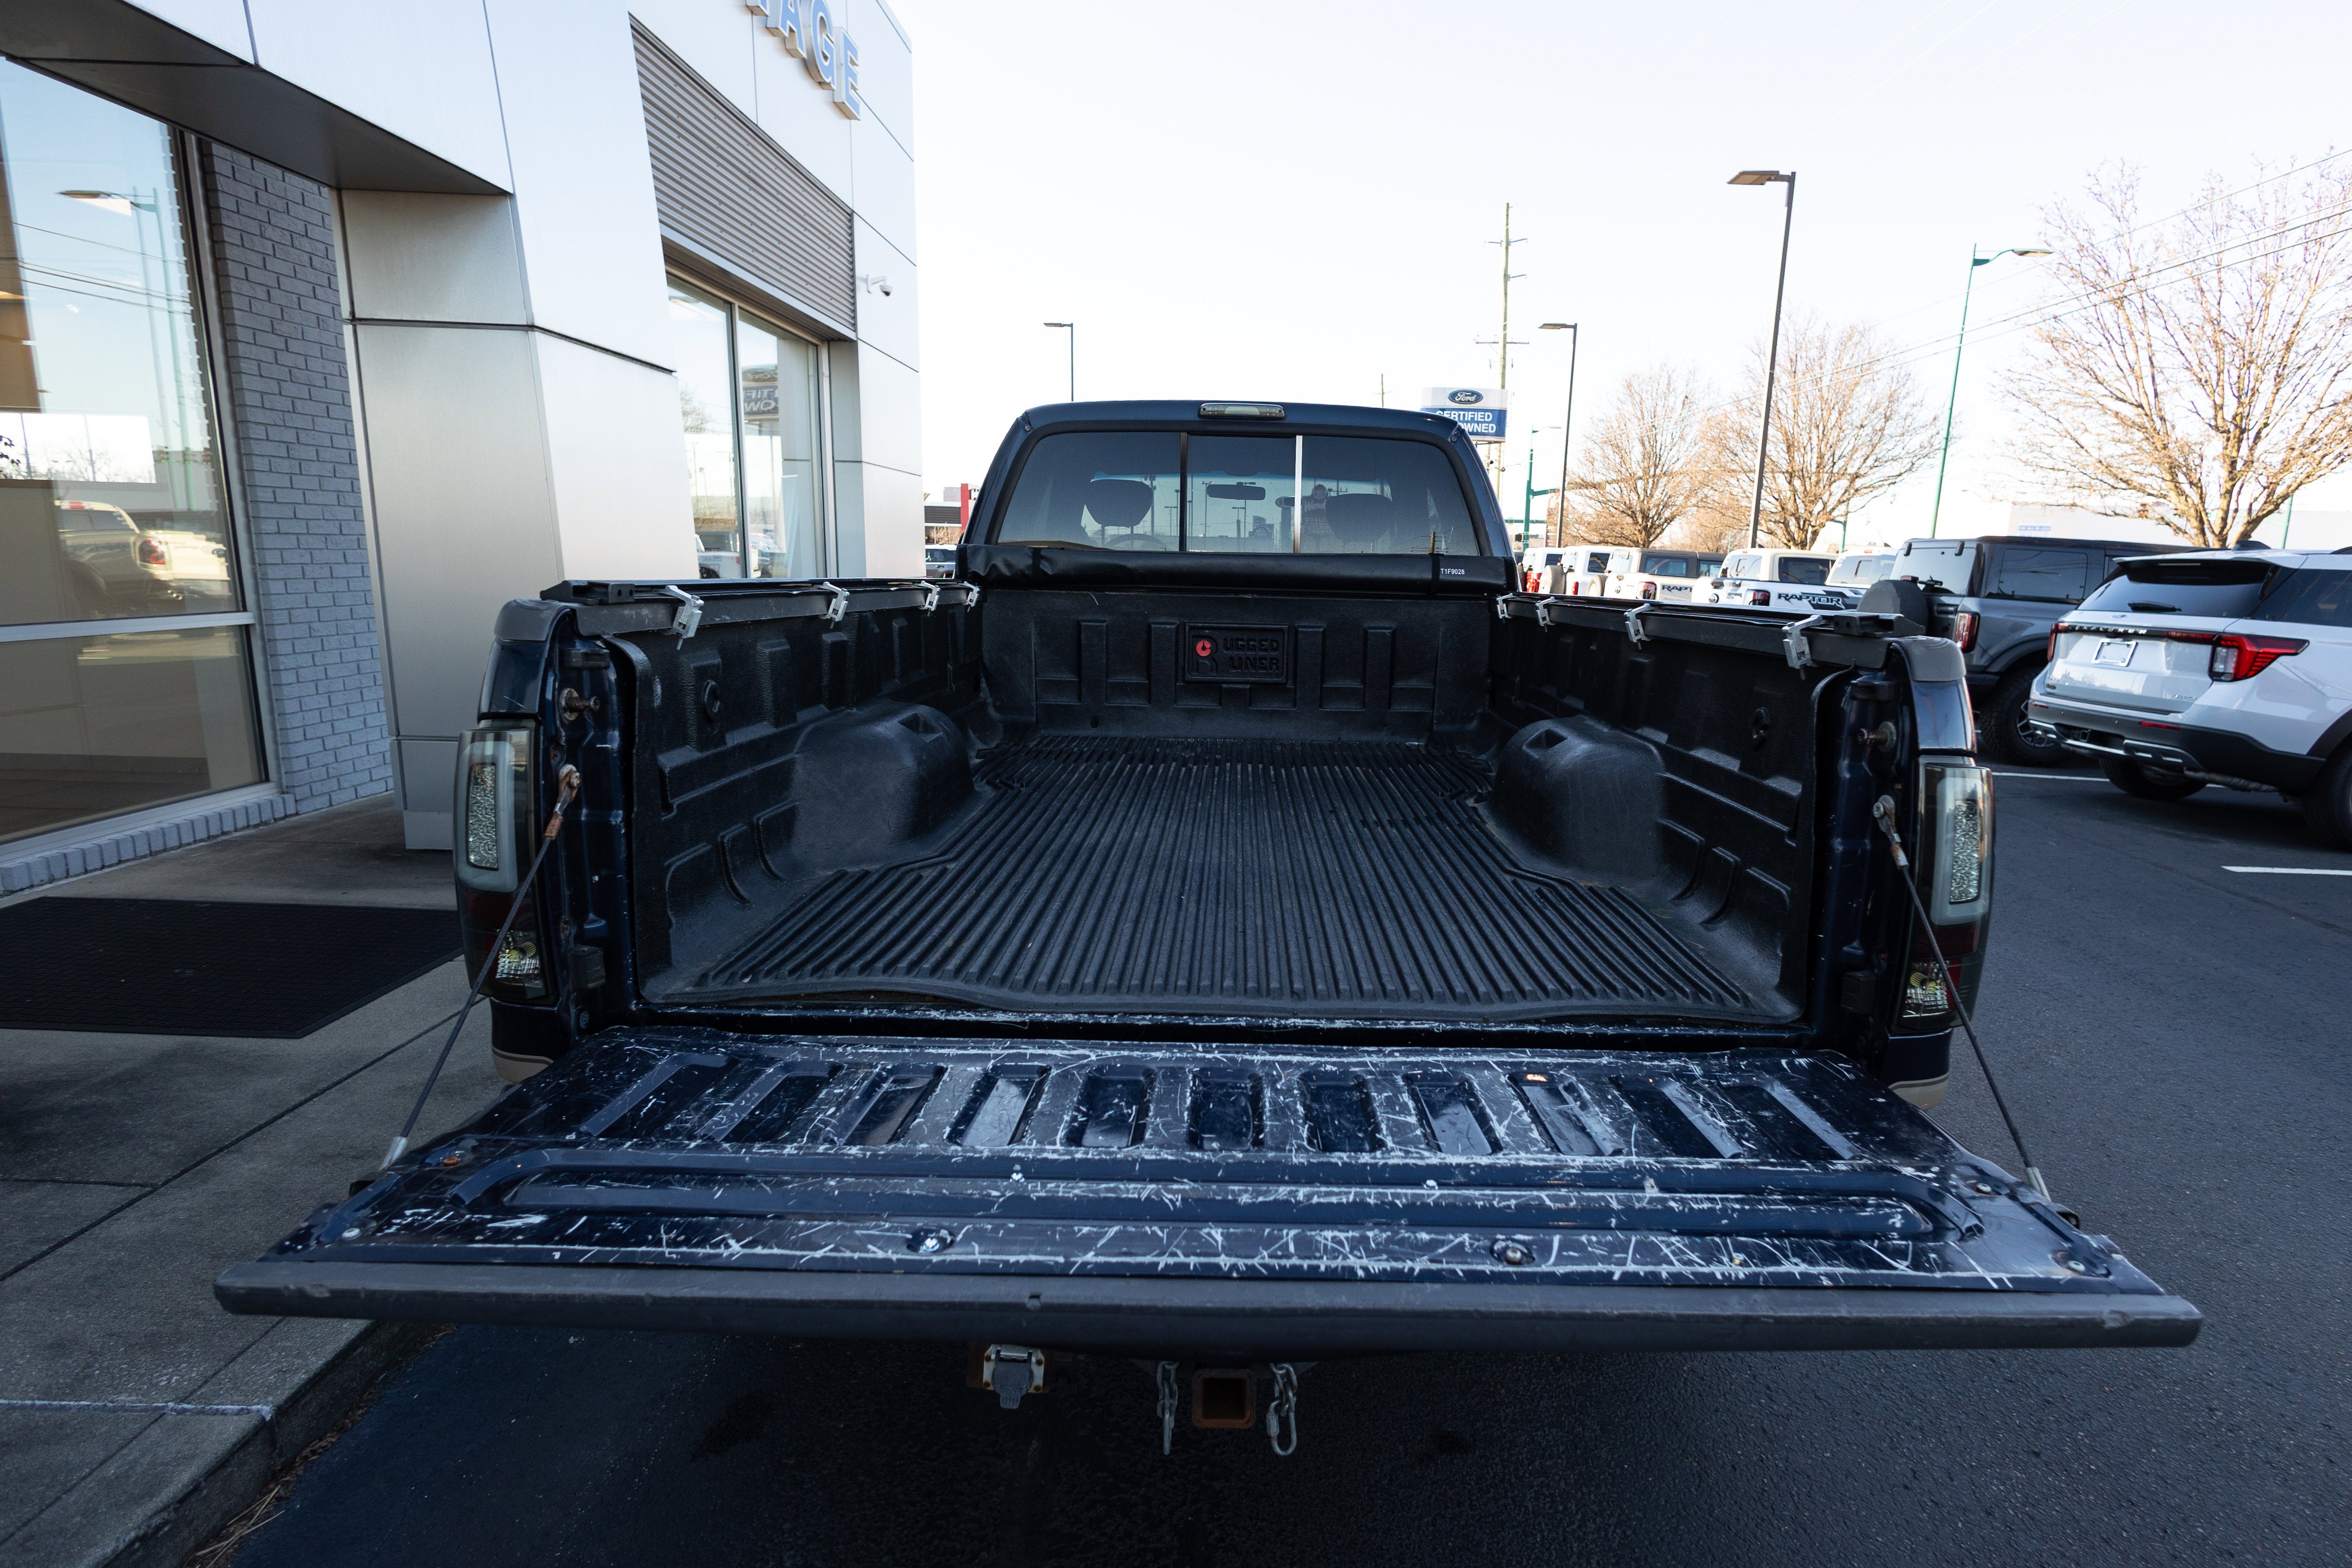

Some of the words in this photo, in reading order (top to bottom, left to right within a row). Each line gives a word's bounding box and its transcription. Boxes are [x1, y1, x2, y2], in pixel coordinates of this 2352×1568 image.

[746, 0, 860, 120] AGE
[1455, 392, 1476, 401] Ford
[1662, 585, 1692, 593] RAPT
[1777, 593, 1845, 609] RAPTOR
[1229, 656, 1279, 672] LINER
